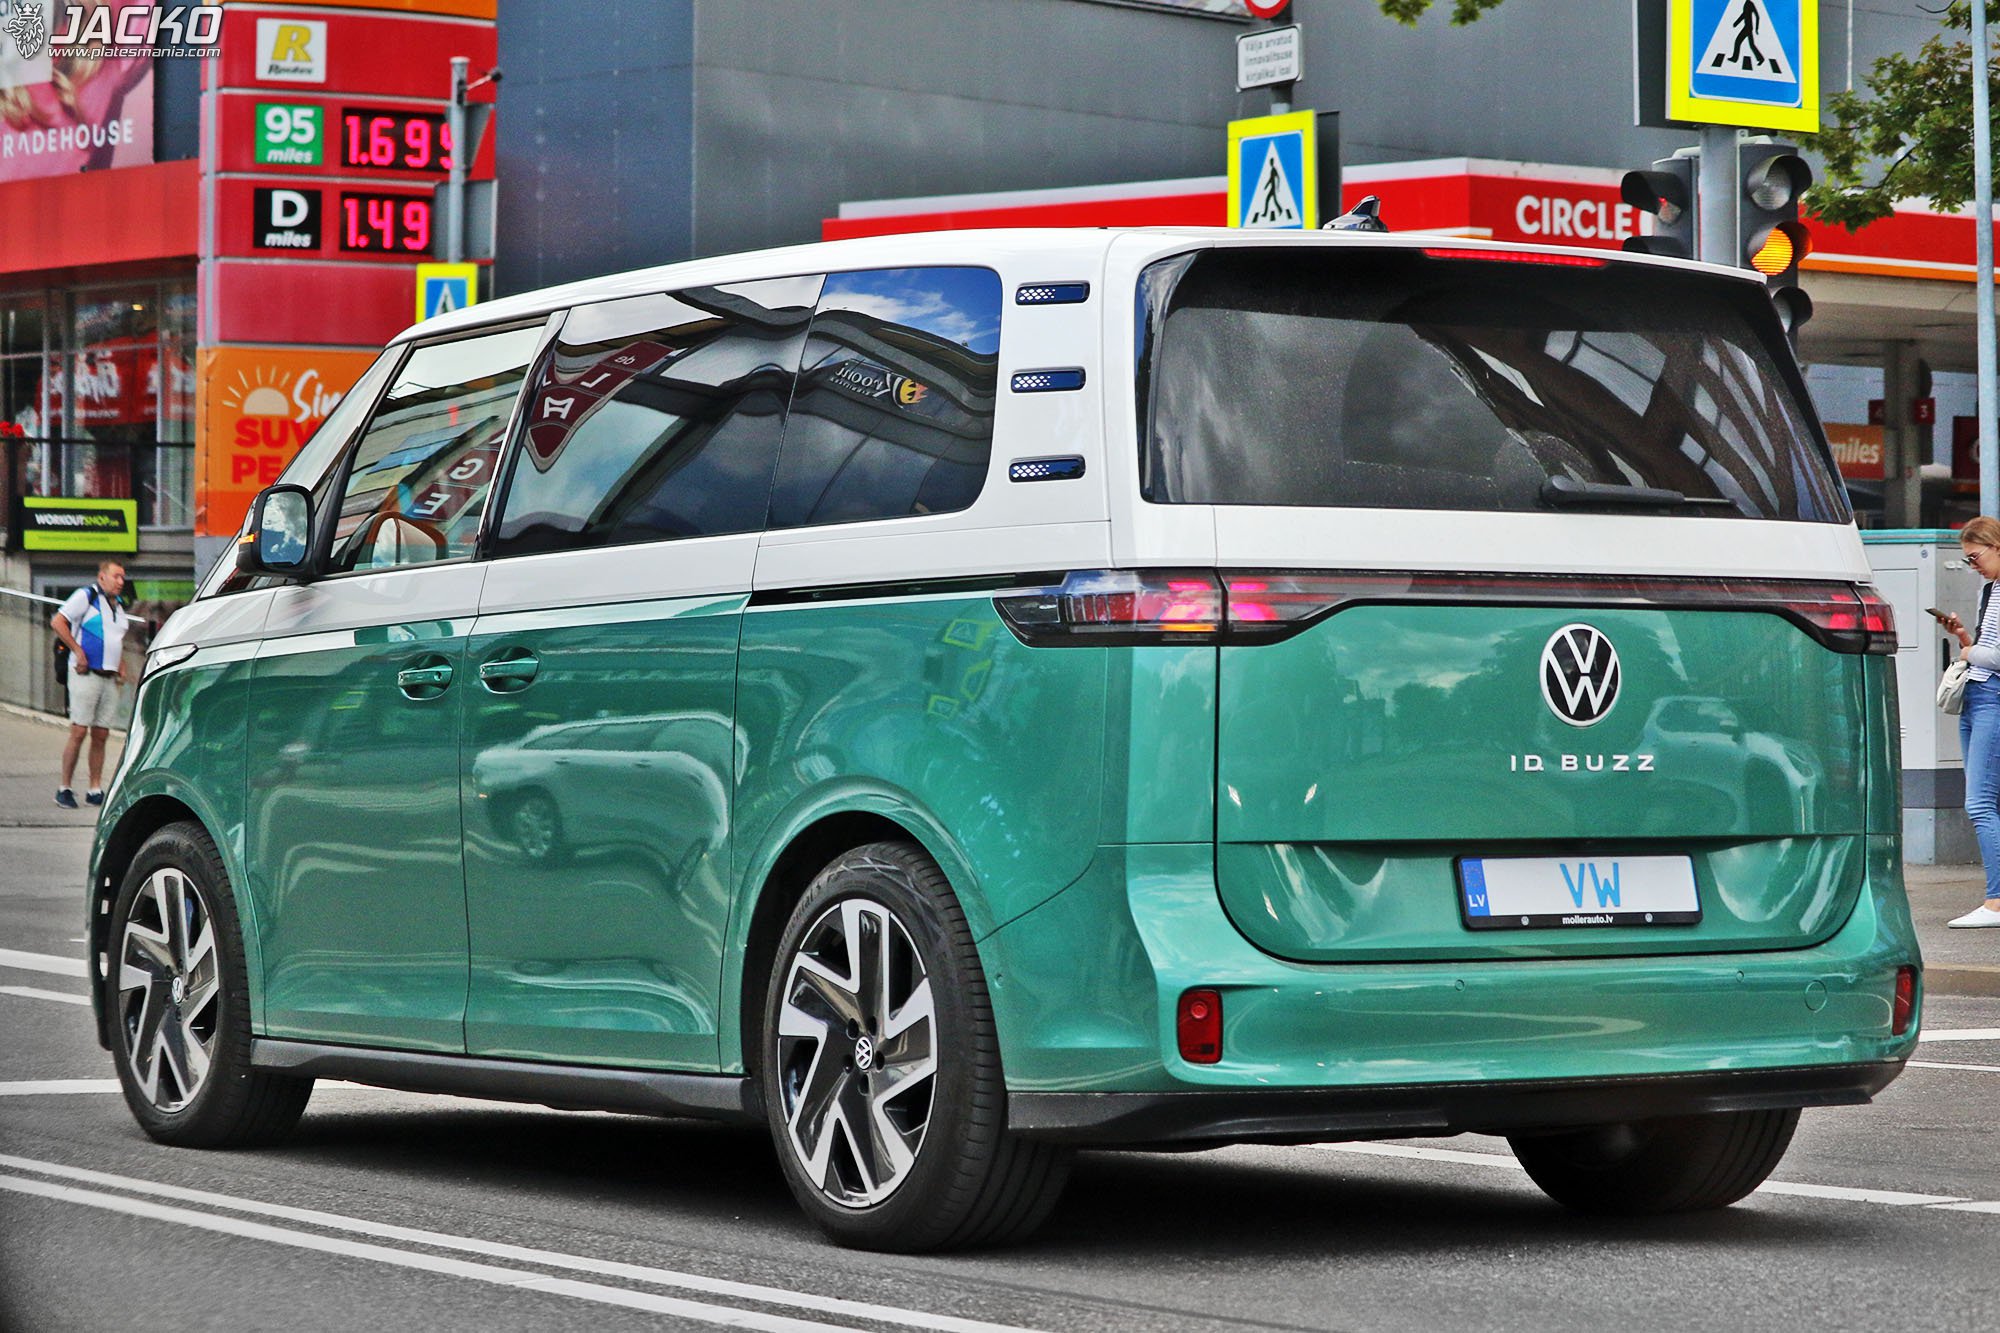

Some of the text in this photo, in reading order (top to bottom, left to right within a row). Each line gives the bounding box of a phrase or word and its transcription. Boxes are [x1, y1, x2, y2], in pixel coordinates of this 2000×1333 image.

[272, 24, 312, 62] R
[0, 118, 133, 157] RADEHOUSE
[264, 106, 316, 144] 95
[266, 148, 313, 164] miles
[271, 189, 309, 228] D
[1516, 194, 1633, 241] CIRCLE
[265, 231, 312, 248] miles
[234, 417, 320, 449] SUV
[231, 453, 284, 485] PE
[1561, 755, 1654, 771] BUZZ
[1468, 894, 1485, 907] LV
[1560, 863, 1620, 908] VW
[1562, 914, 1614, 925] mollerauto.lv
